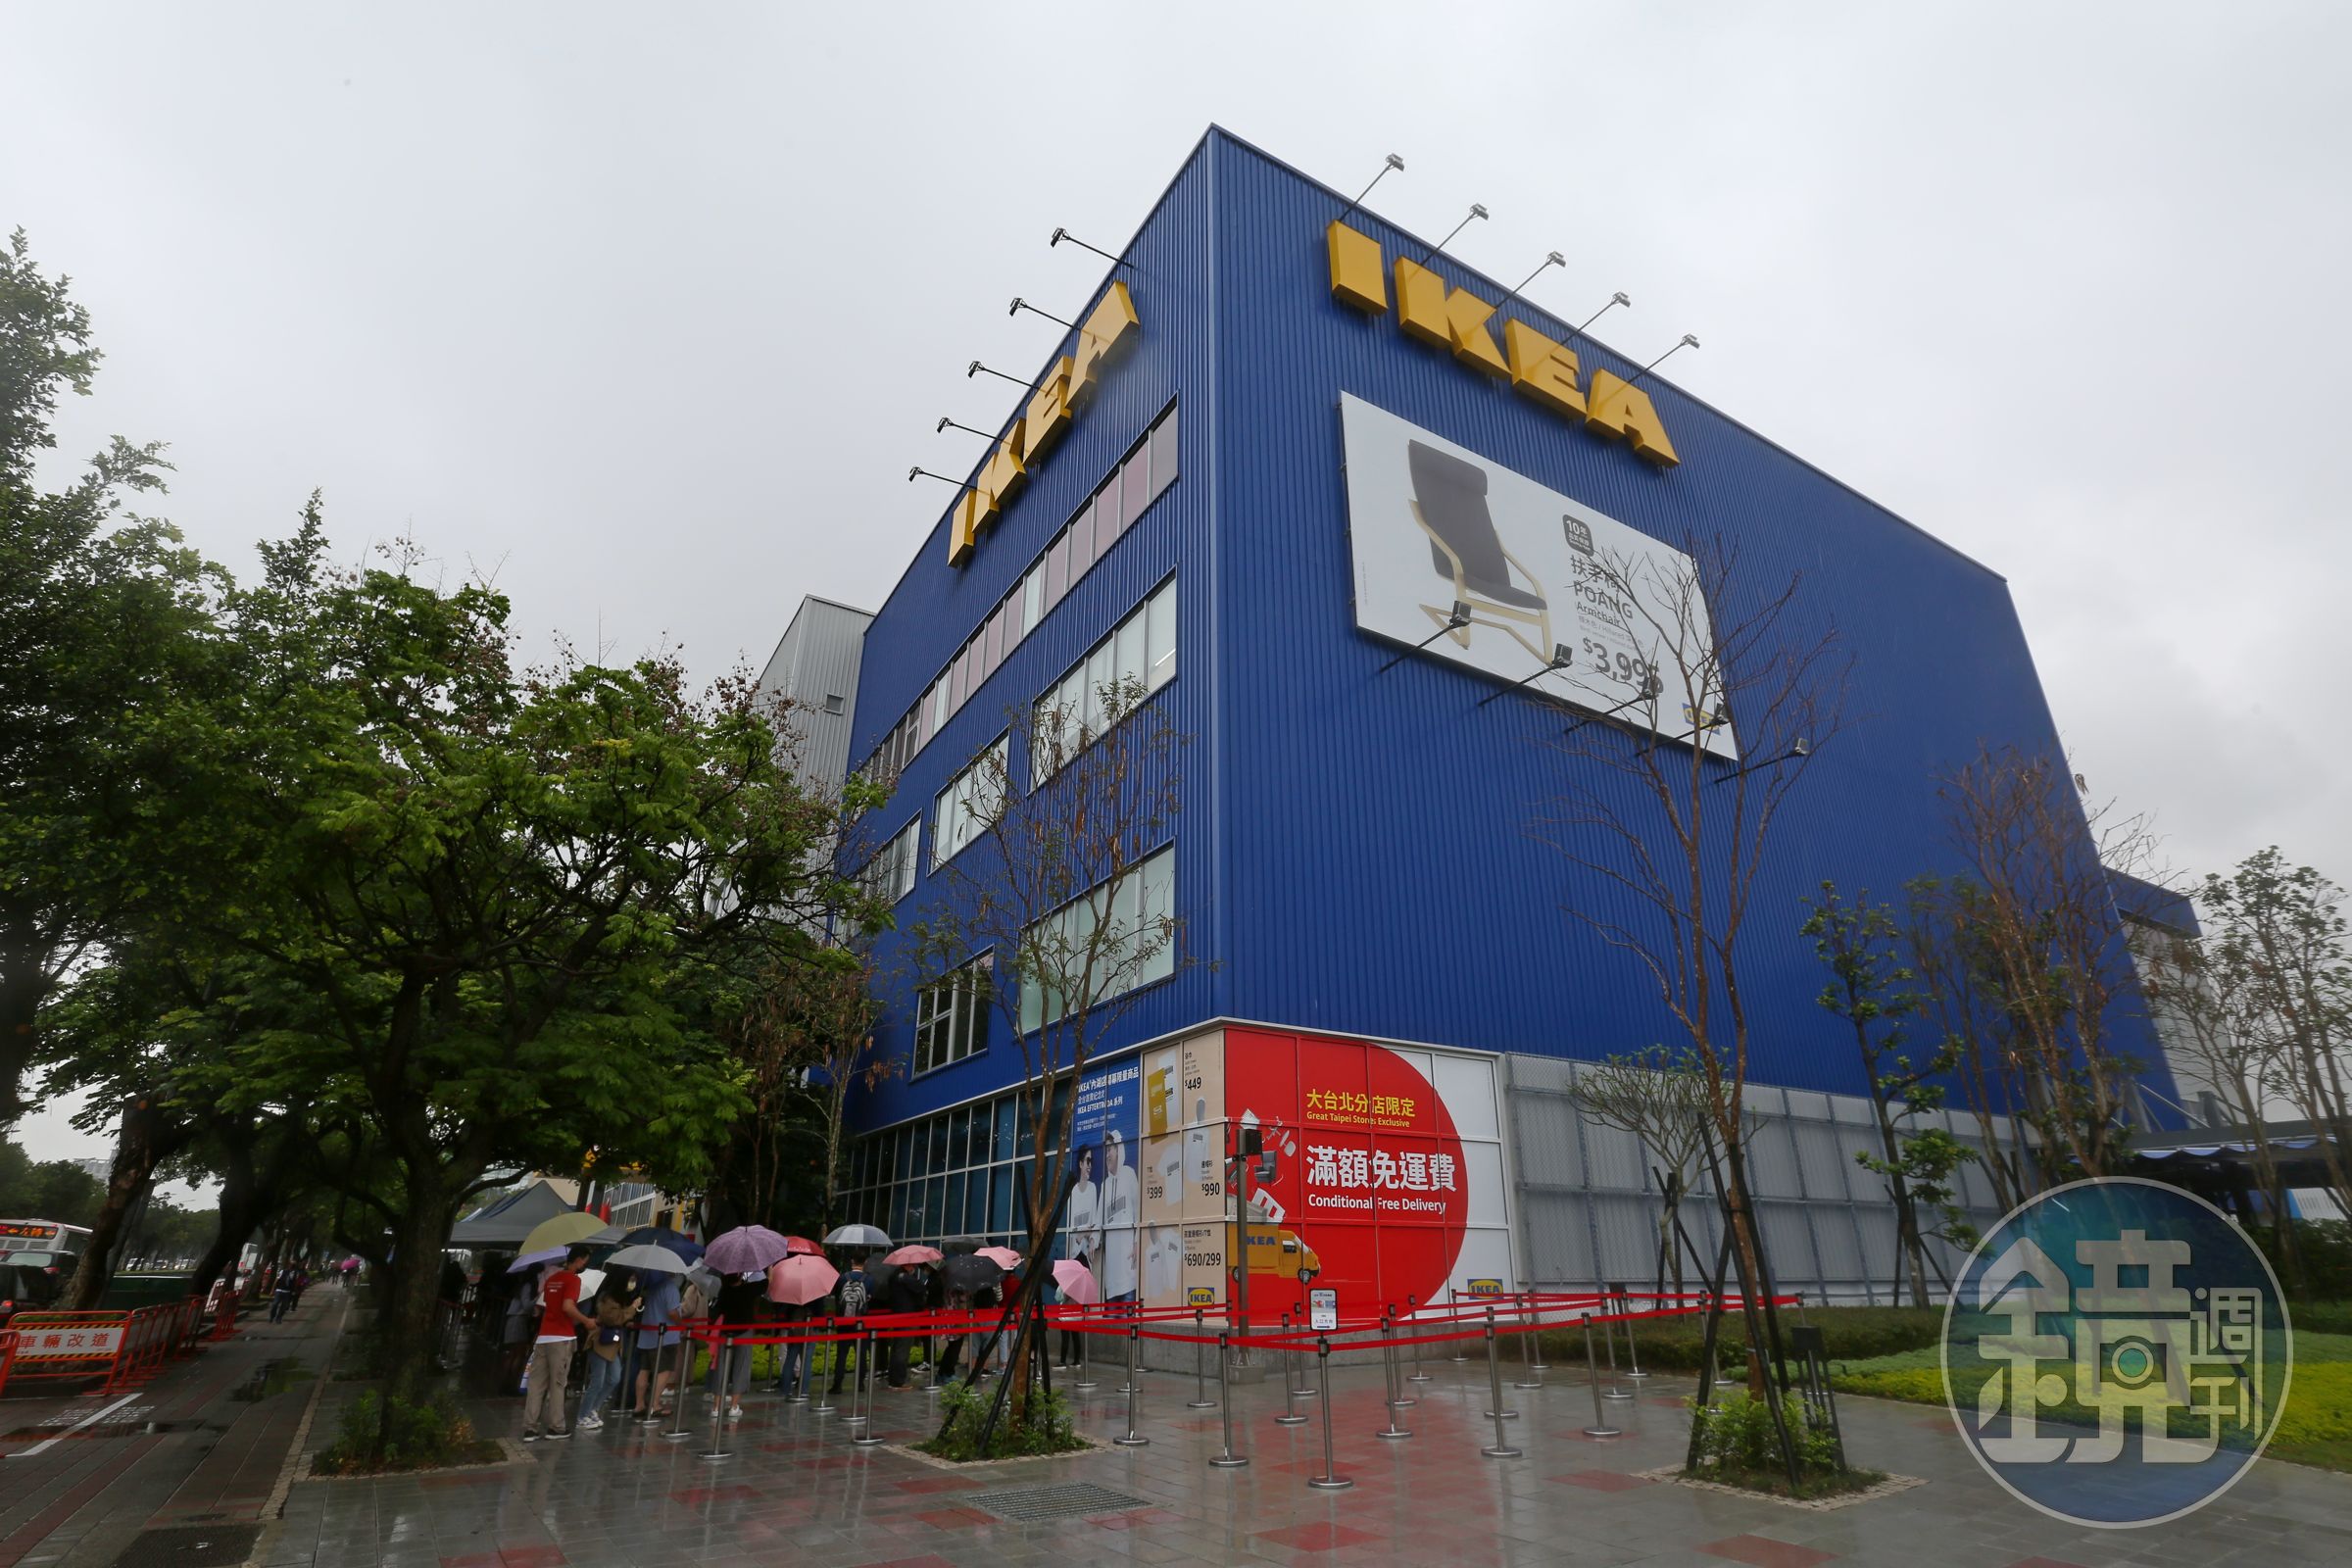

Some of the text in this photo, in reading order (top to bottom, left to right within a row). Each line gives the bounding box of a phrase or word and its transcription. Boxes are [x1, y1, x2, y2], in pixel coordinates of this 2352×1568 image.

[1327, 220, 1680, 468] IKEA
[948, 280, 1140, 566] IKEA
[1577, 601, 1621, 627] Armchair
[1185, 1077, 1201, 1090] $449
[1306, 1089, 1416, 1117] 大台北分店限定
[1306, 1111, 1328, 1121] Great
[1329, 1113, 1351, 1124] Taipei
[1378, 1118, 1410, 1128] Exclusive
[1306, 1145, 1456, 1192] 滿額免運費
[1147, 1186, 1163, 1200] $399
[1201, 1182, 1220, 1197] $990
[1308, 1194, 1446, 1215] Conditional Free Delivery
[1184, 1252, 1221, 1267] $690/299
[1470, 1285, 1500, 1295] IKEA
[1190, 1294, 1212, 1303] IKEA
[19, 1333, 110, 1348] 車輛改道
